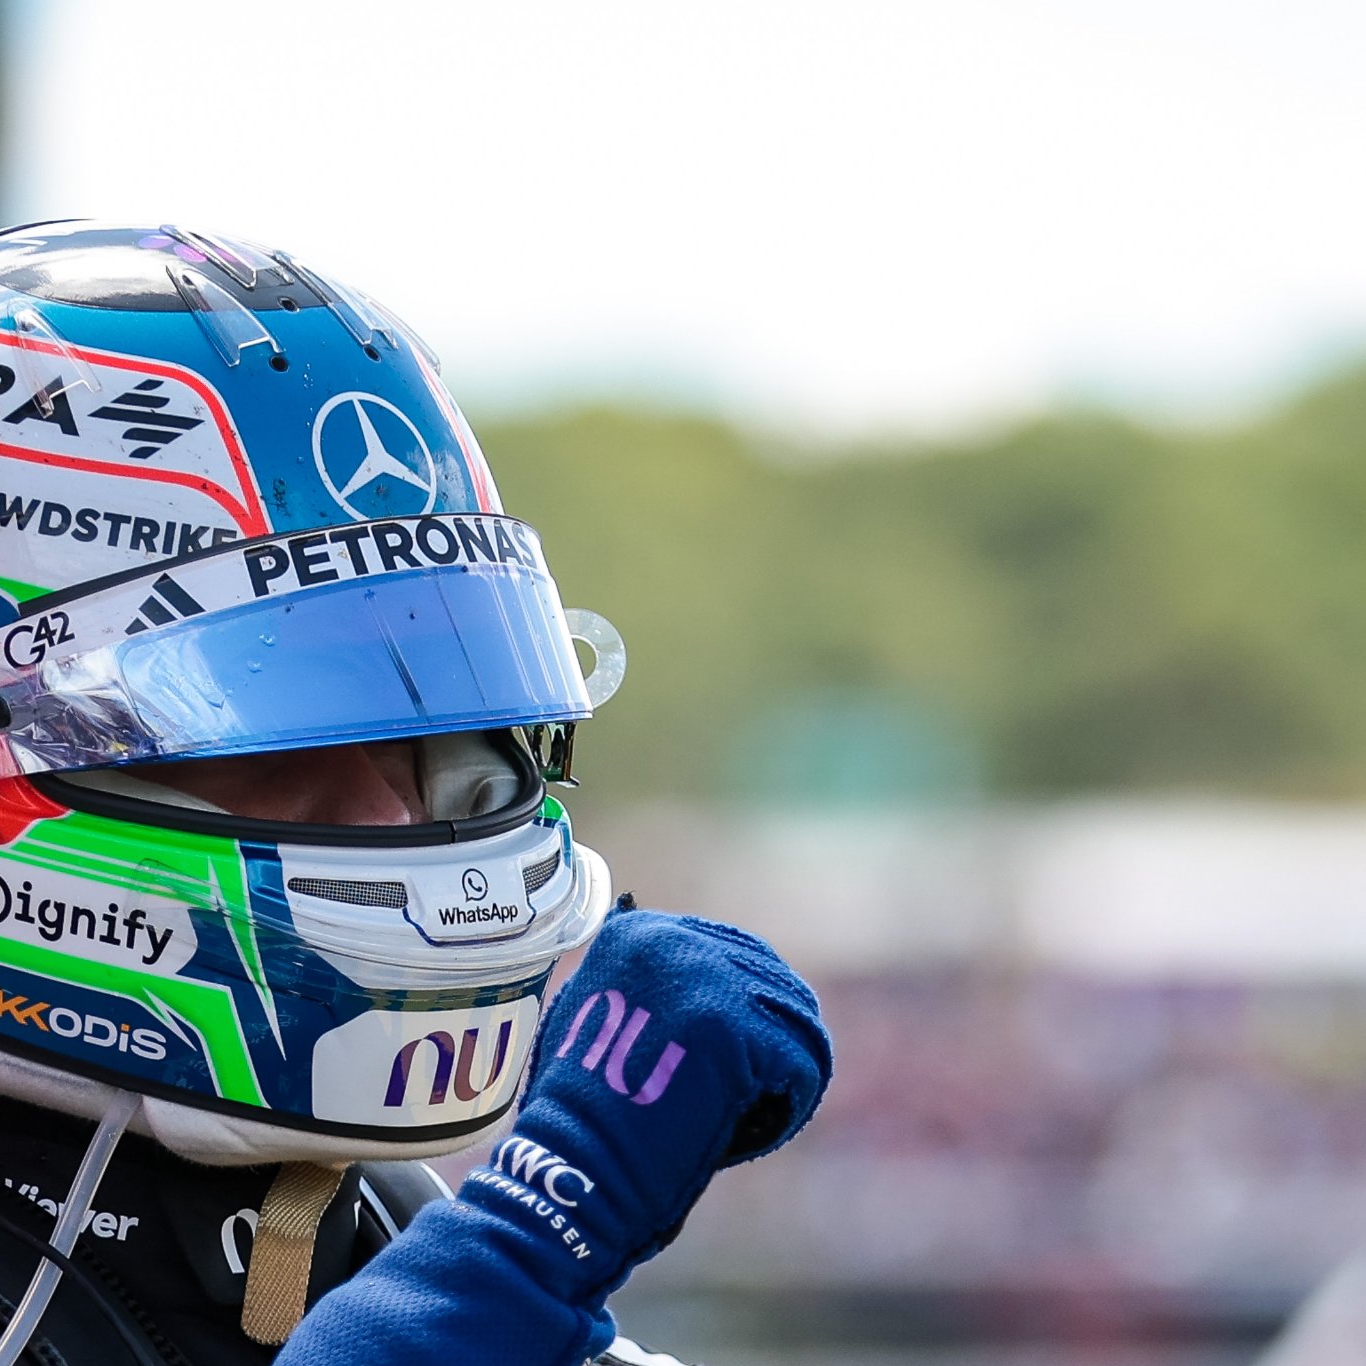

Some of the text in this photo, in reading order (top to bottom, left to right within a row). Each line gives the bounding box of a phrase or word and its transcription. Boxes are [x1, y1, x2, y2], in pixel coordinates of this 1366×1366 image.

[243, 518, 538, 597] PETRONAS
[4, 611, 76, 668] G42
[438, 902, 519, 926] WhatsApp
[493, 1136, 595, 1207] IWC
